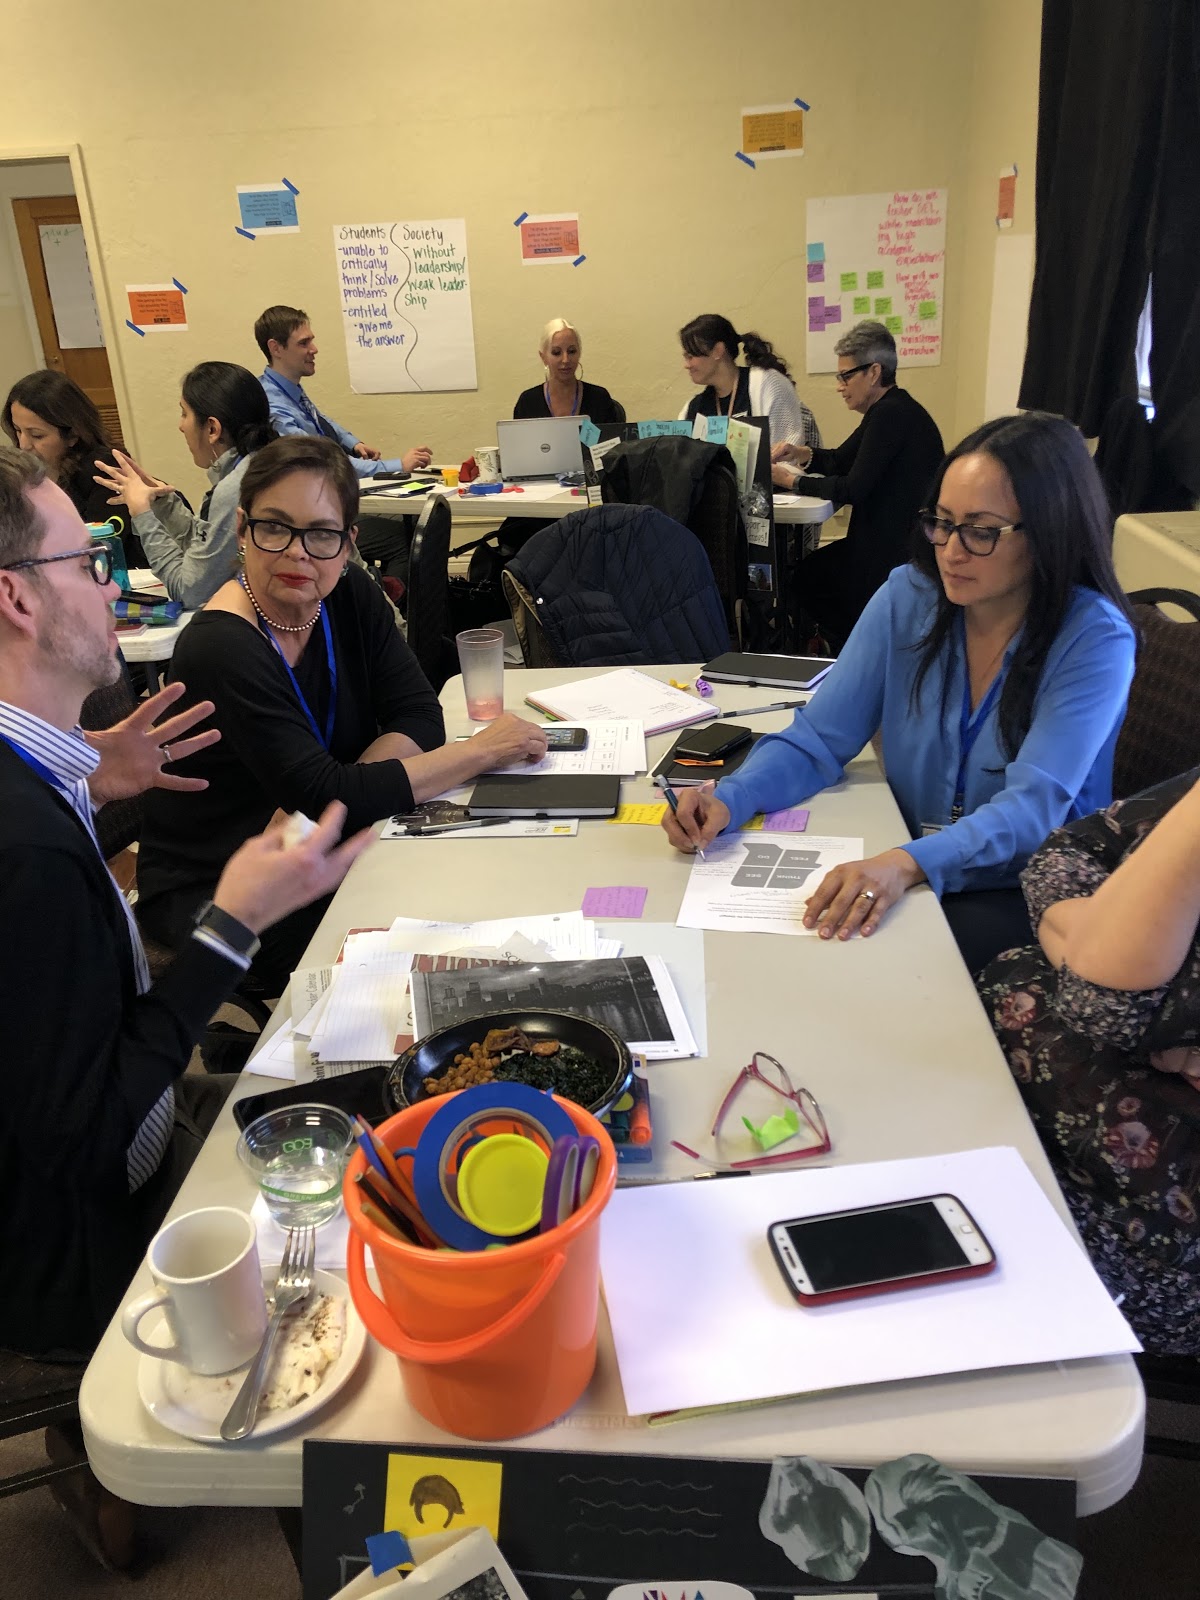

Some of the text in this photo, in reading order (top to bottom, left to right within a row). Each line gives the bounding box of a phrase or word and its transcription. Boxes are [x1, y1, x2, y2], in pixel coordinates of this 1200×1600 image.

[340, 226, 386, 240] Students
[403, 226, 444, 246] Society
[379, 244, 388, 255] to
[342, 258, 388, 272] critically
[344, 287, 388, 303] problems
[380, 320, 393, 330] me
[356, 334, 405, 348] the answer
